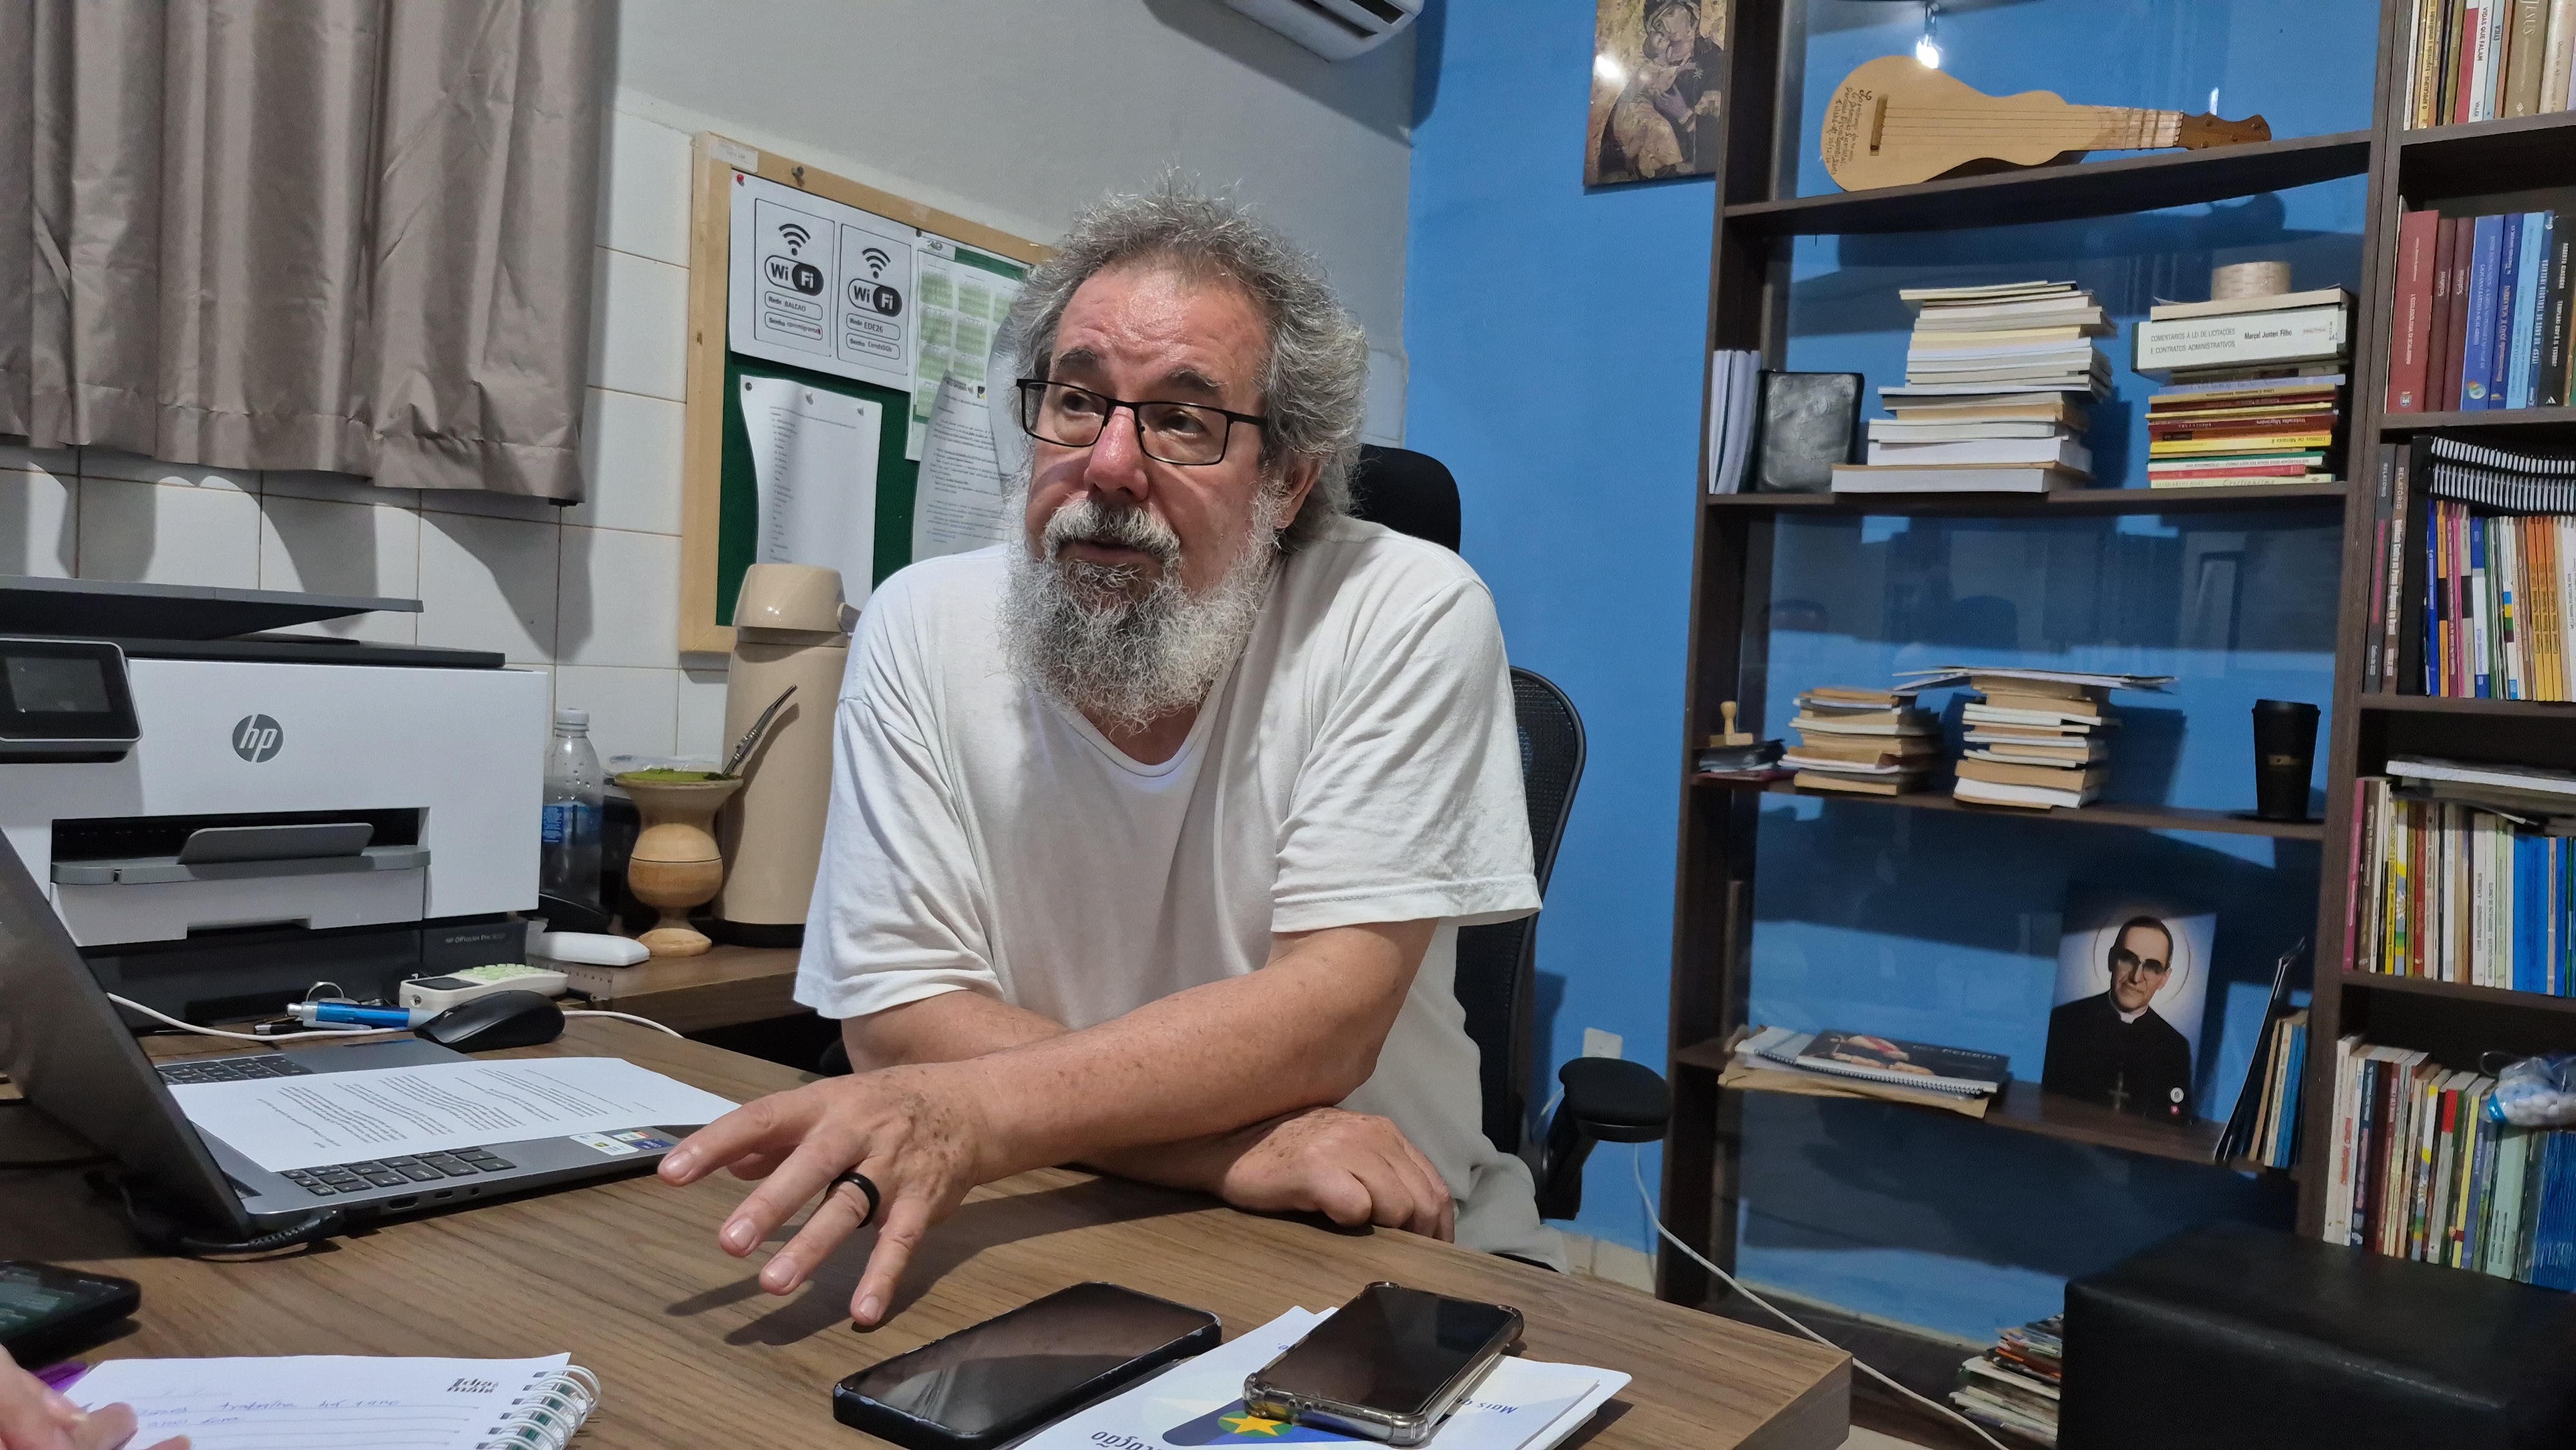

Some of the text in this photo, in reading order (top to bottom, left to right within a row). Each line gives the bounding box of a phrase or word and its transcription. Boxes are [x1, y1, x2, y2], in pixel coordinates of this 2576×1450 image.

[771, 263, 814, 288] Wi Fi
[854, 285, 893, 310] Wi Fi
[2151, 332, 2184, 342] COMENTÁRIOS
[2244, 332, 2260, 340] Marçal
[2155, 344, 2186, 353] CONTRATOS
[2188, 341, 2235, 351] ADMINISTRATIVOS
[235, 714, 281, 763] hp
[1477, 1403, 1519, 1414] Mais
